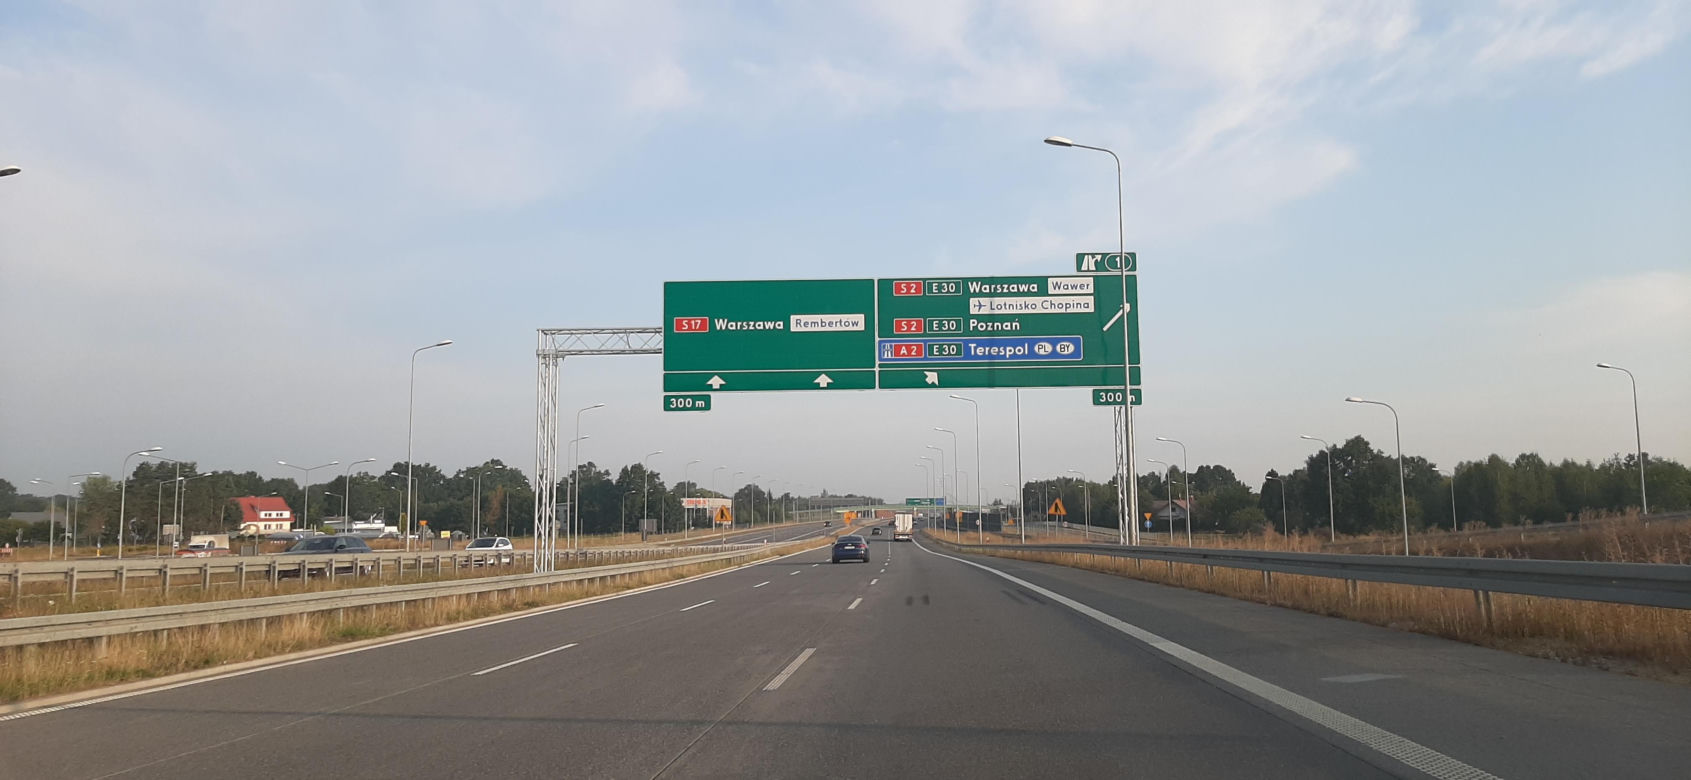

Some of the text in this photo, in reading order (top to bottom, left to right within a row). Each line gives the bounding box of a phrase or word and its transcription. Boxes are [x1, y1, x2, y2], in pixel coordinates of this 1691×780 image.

[900, 283, 916, 293] S 2
[932, 283, 956, 293] E 30
[968, 281, 1038, 293] Warszawa
[1052, 281, 1090, 291] Wawer
[990, 300, 1090, 312] Lotnisko Chopina
[682, 320, 701, 330] S 17
[714, 318, 784, 331] Warszawa
[795, 317, 859, 328] Rembertów
[901, 321, 917, 331] S 2
[933, 321, 956, 330] E 30
[969, 318, 1020, 331] Poznań
[900, 345, 917, 355] A 2
[933, 345, 957, 355] E 30
[969, 343, 1029, 358] Terespol
[1037, 344, 1049, 353] PL
[1059, 344, 1070, 353] BY
[1099, 392, 1122, 402] 300
[669, 398, 705, 408] 300 m
